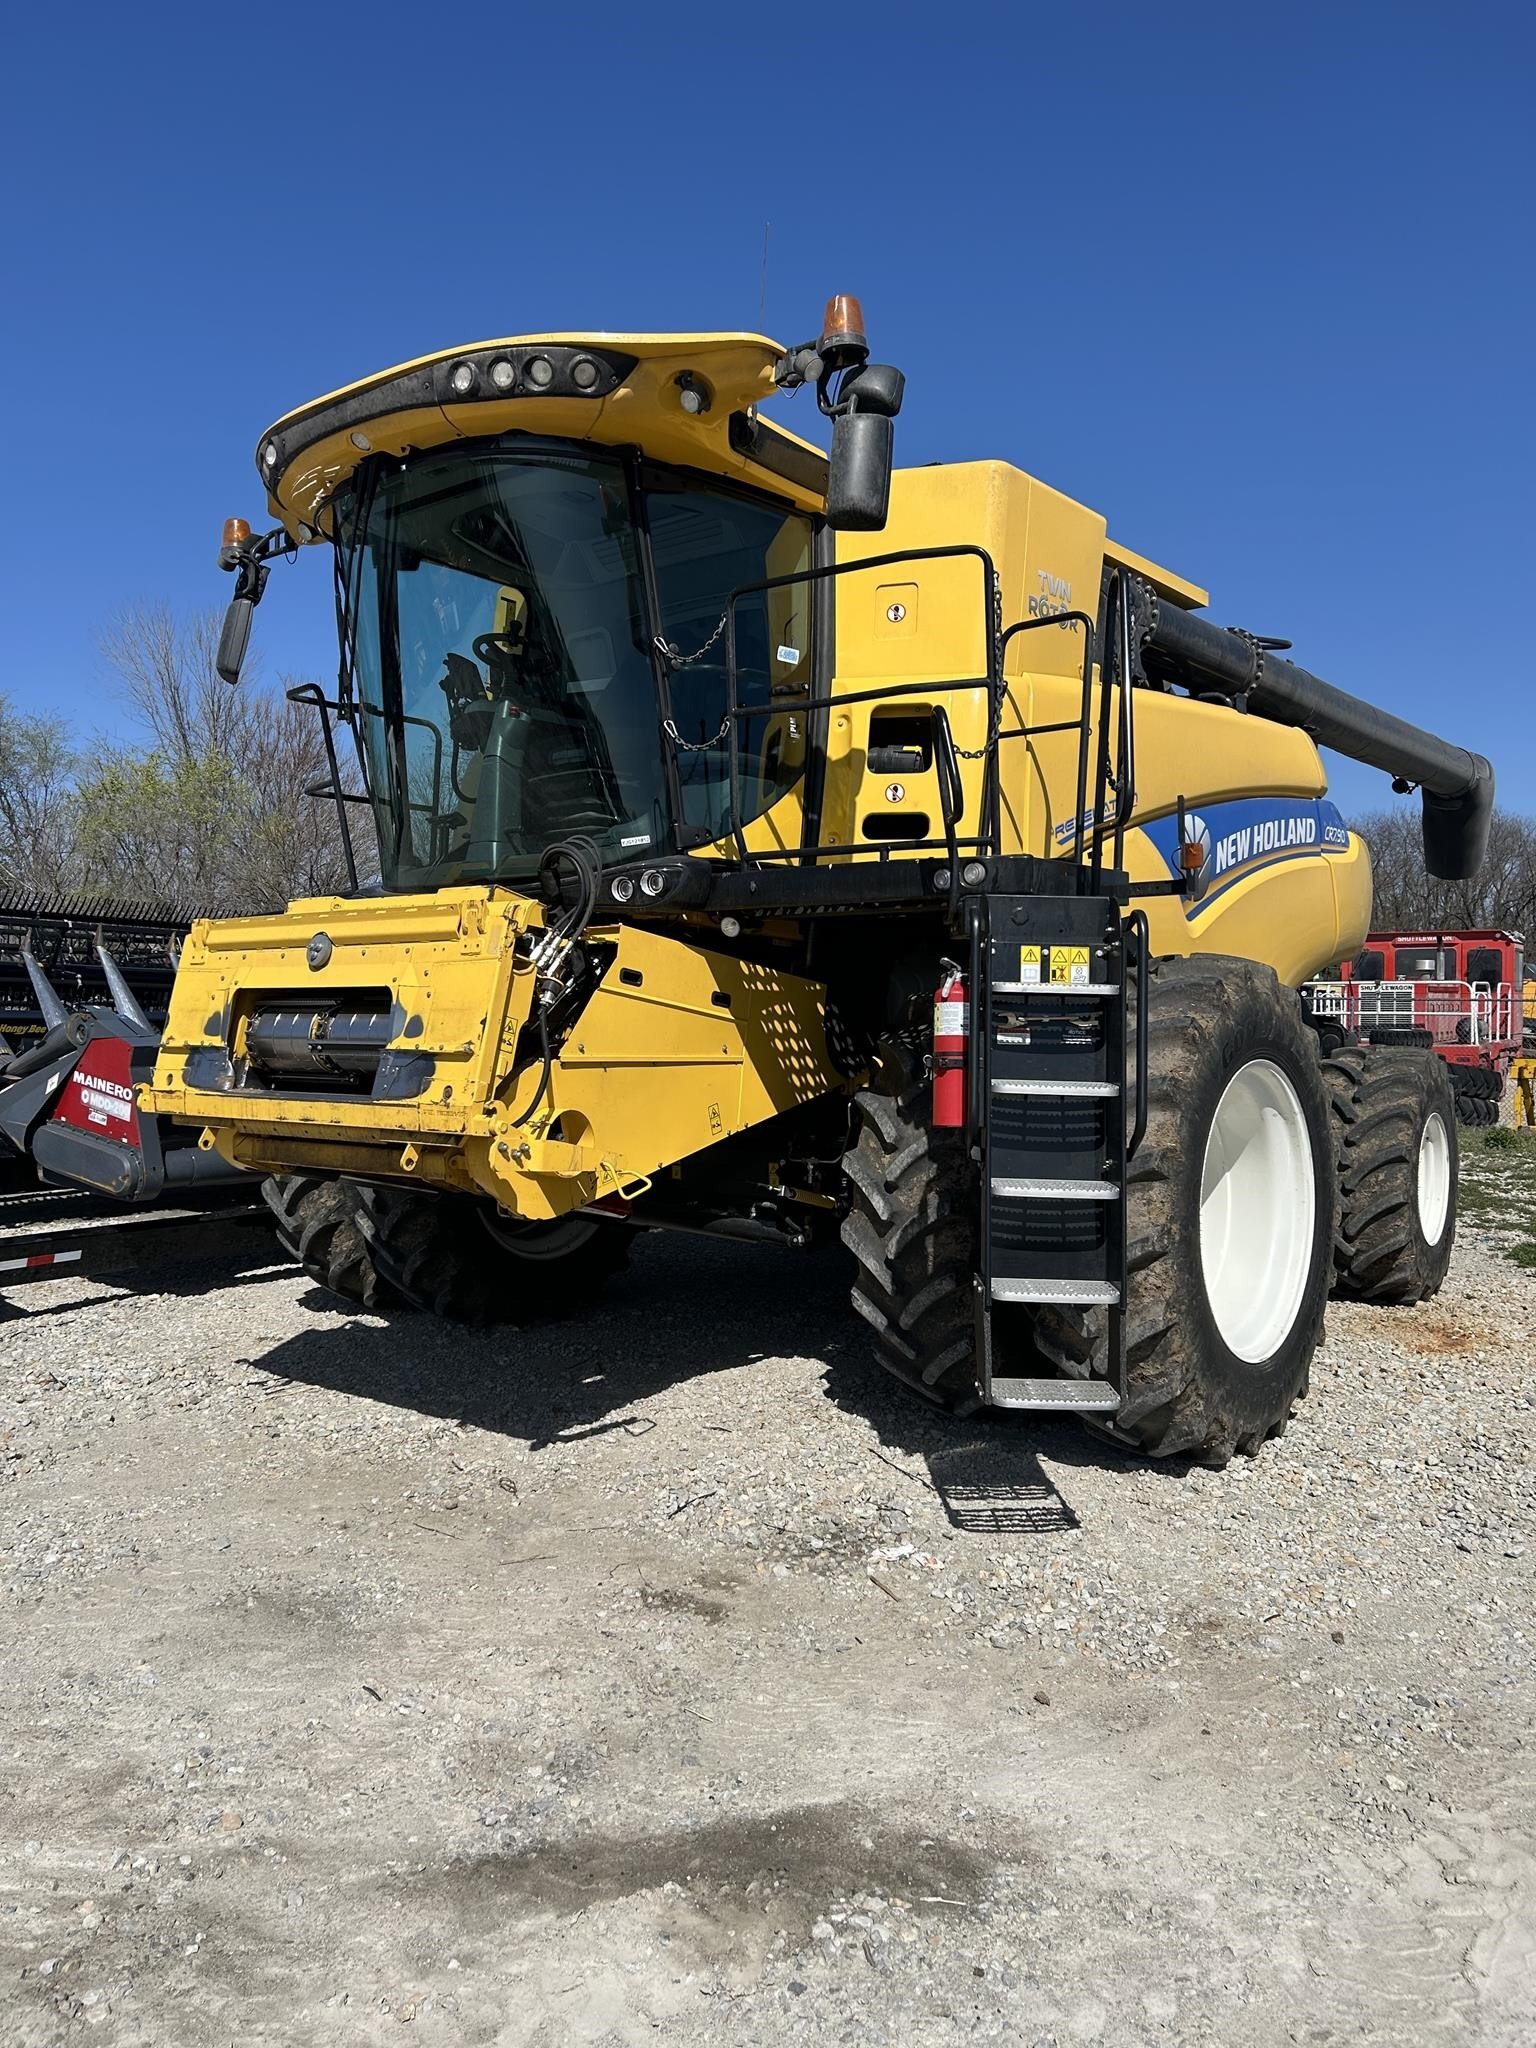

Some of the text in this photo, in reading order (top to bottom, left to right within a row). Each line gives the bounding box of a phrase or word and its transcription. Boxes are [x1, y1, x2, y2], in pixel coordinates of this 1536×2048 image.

[1038, 569, 1071, 603] TWIN
[1215, 817, 1316, 875] NEW HOLLAND
[0, 1023, 47, 1035] Honey Bee
[73, 1070, 133, 1101] MAINERO
